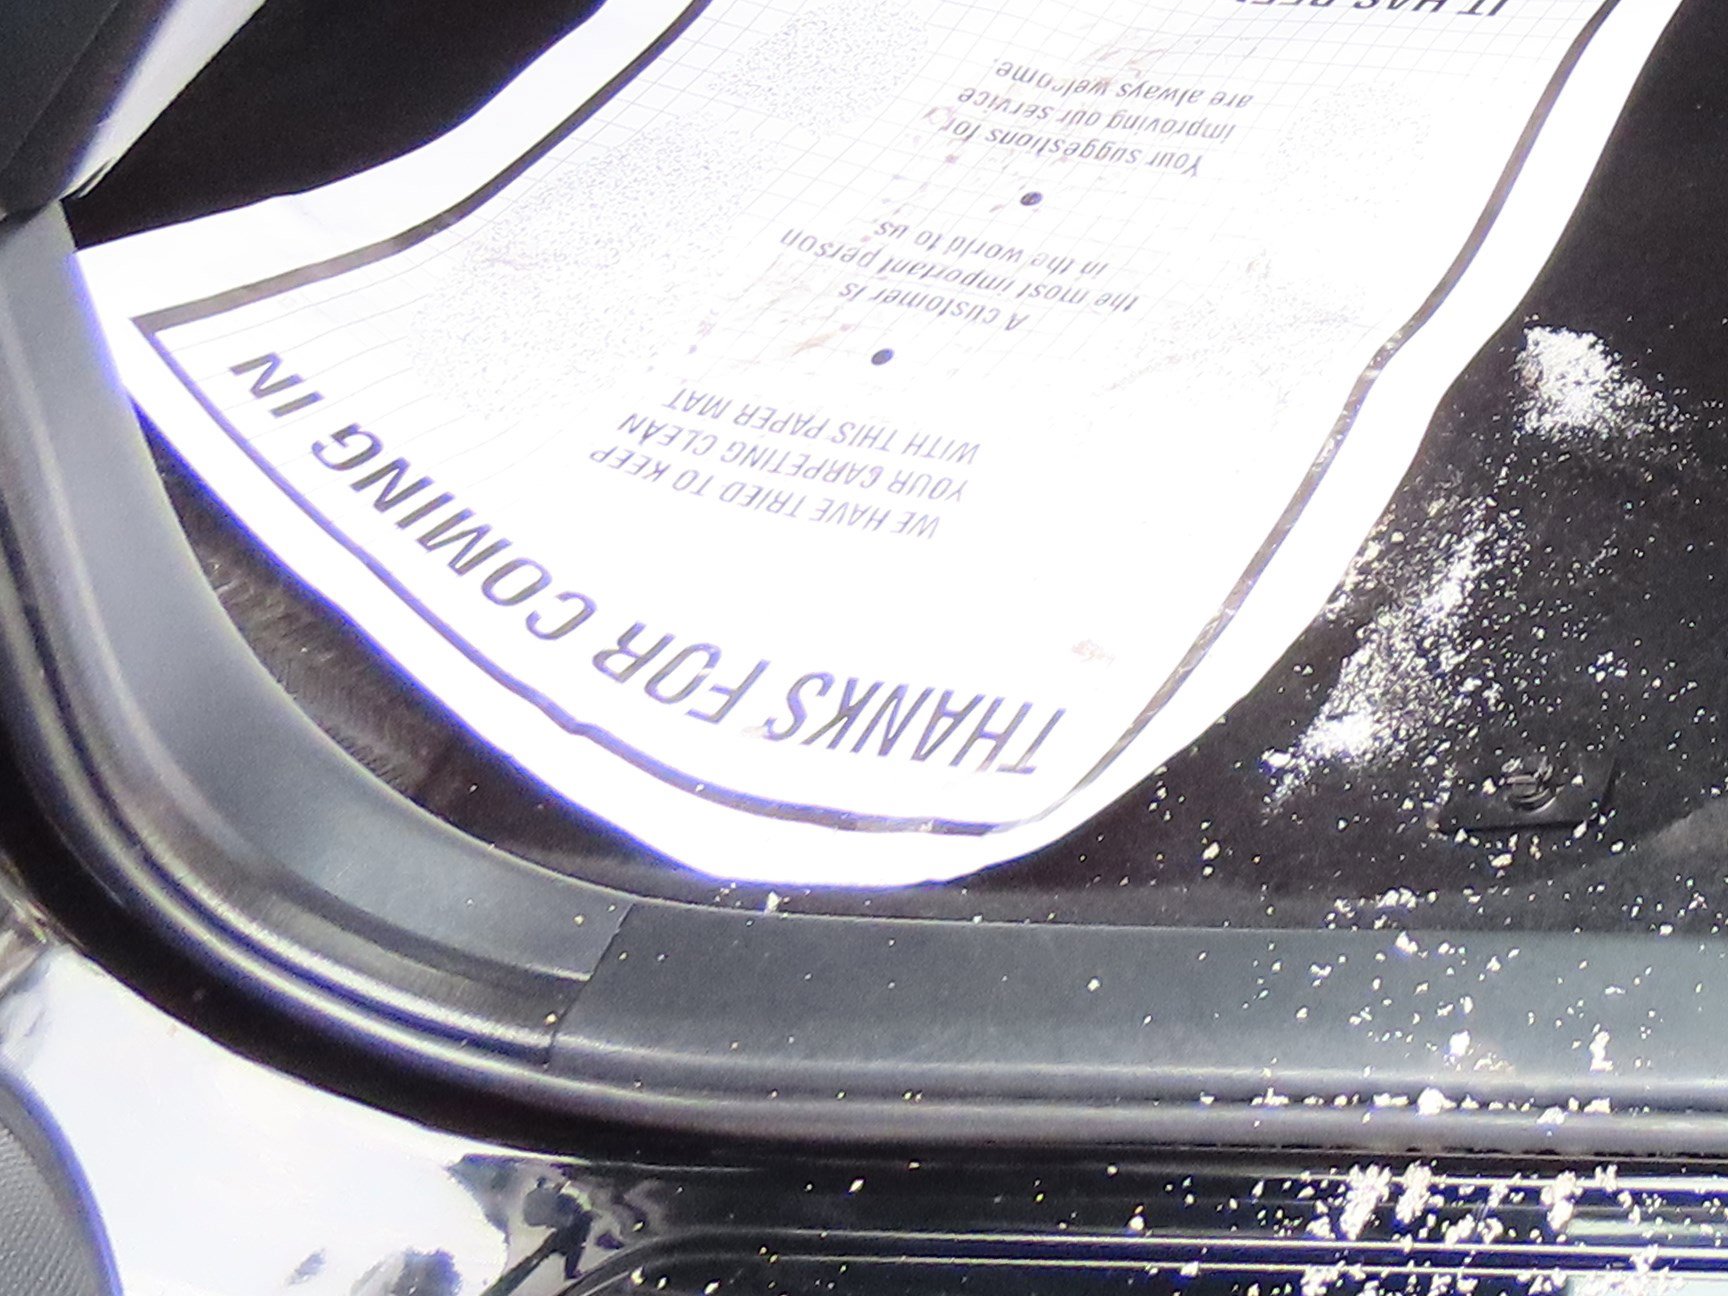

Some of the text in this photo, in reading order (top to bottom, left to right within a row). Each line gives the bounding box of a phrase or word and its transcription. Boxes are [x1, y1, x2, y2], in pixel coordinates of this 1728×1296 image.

[956, 86, 1235, 142] improving our service
[1115, 80, 1203, 106] always
[1209, 90, 1253, 108] are
[938, 116, 1201, 177] Your suggestions for
[616, 412, 968, 502] YOUR CARPETING CLEAN
[660, 387, 980, 464] WITH THIS PAPER MAT
[588, 444, 940, 539] WE HAVE TRIED TO KEEP
[228, 351, 1066, 774] THANKS FOR COMING IN
